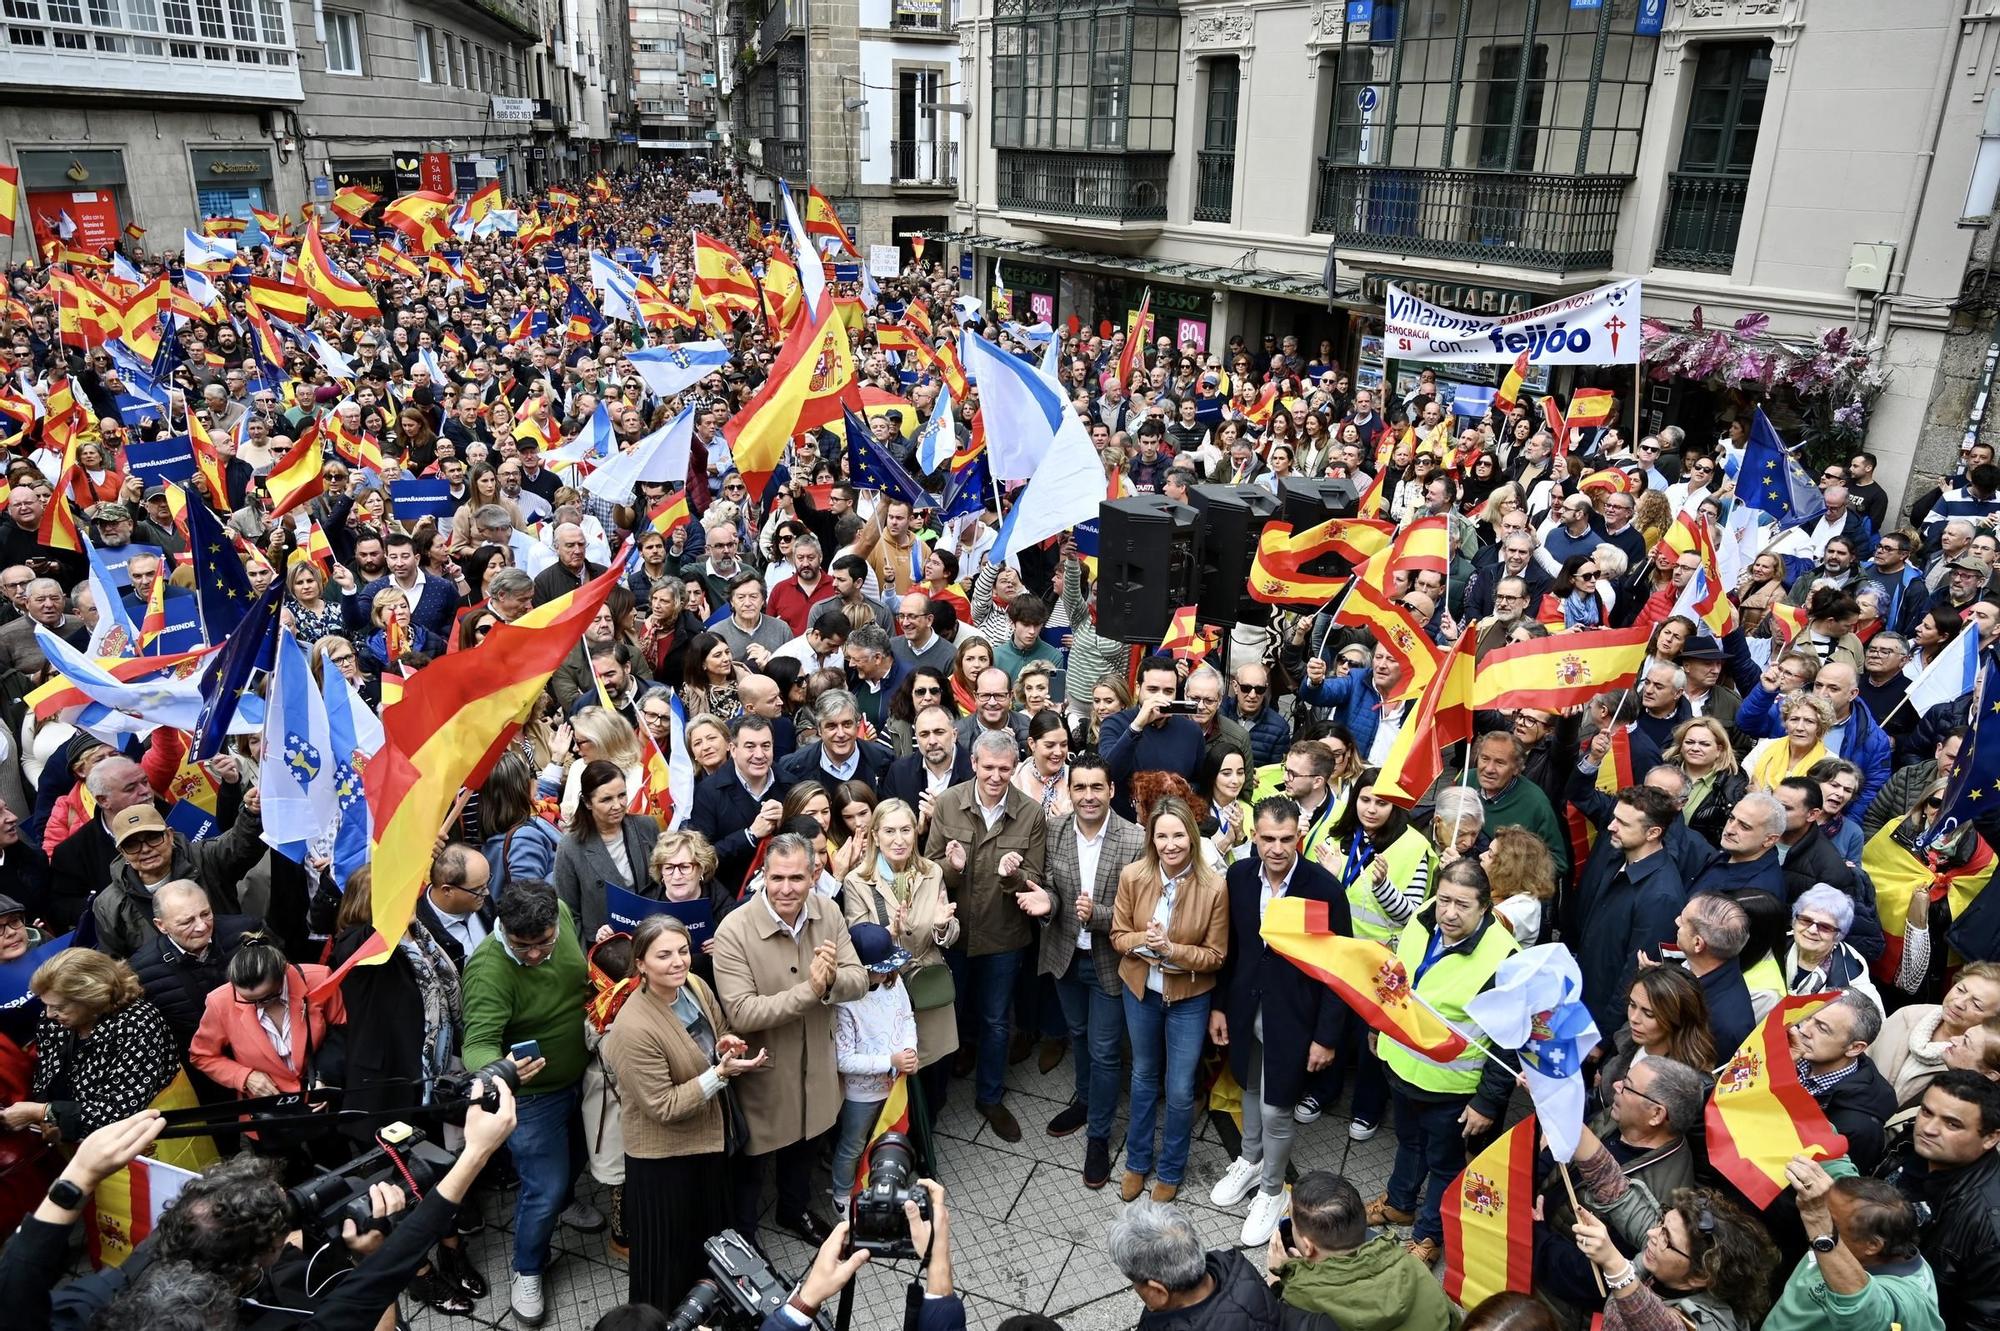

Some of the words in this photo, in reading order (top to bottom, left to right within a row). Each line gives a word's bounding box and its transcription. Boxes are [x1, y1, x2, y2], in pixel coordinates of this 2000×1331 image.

[1640, 17, 1658, 25] ZURICH
[496, 110, 508, 118] 986
[521, 111, 531, 119] 163
[431, 165, 440, 173] SA
[432, 174, 441, 182] RE
[1384, 323, 1430, 340] DEMOCRACIA
[1398, 338, 1411, 351] SI
[1488, 321, 1592, 361] feijóo
[132, 453, 192, 469] #ESPAÑANOSERINDE
[394, 495, 448, 503] #ESPAÑANOSERINDE
